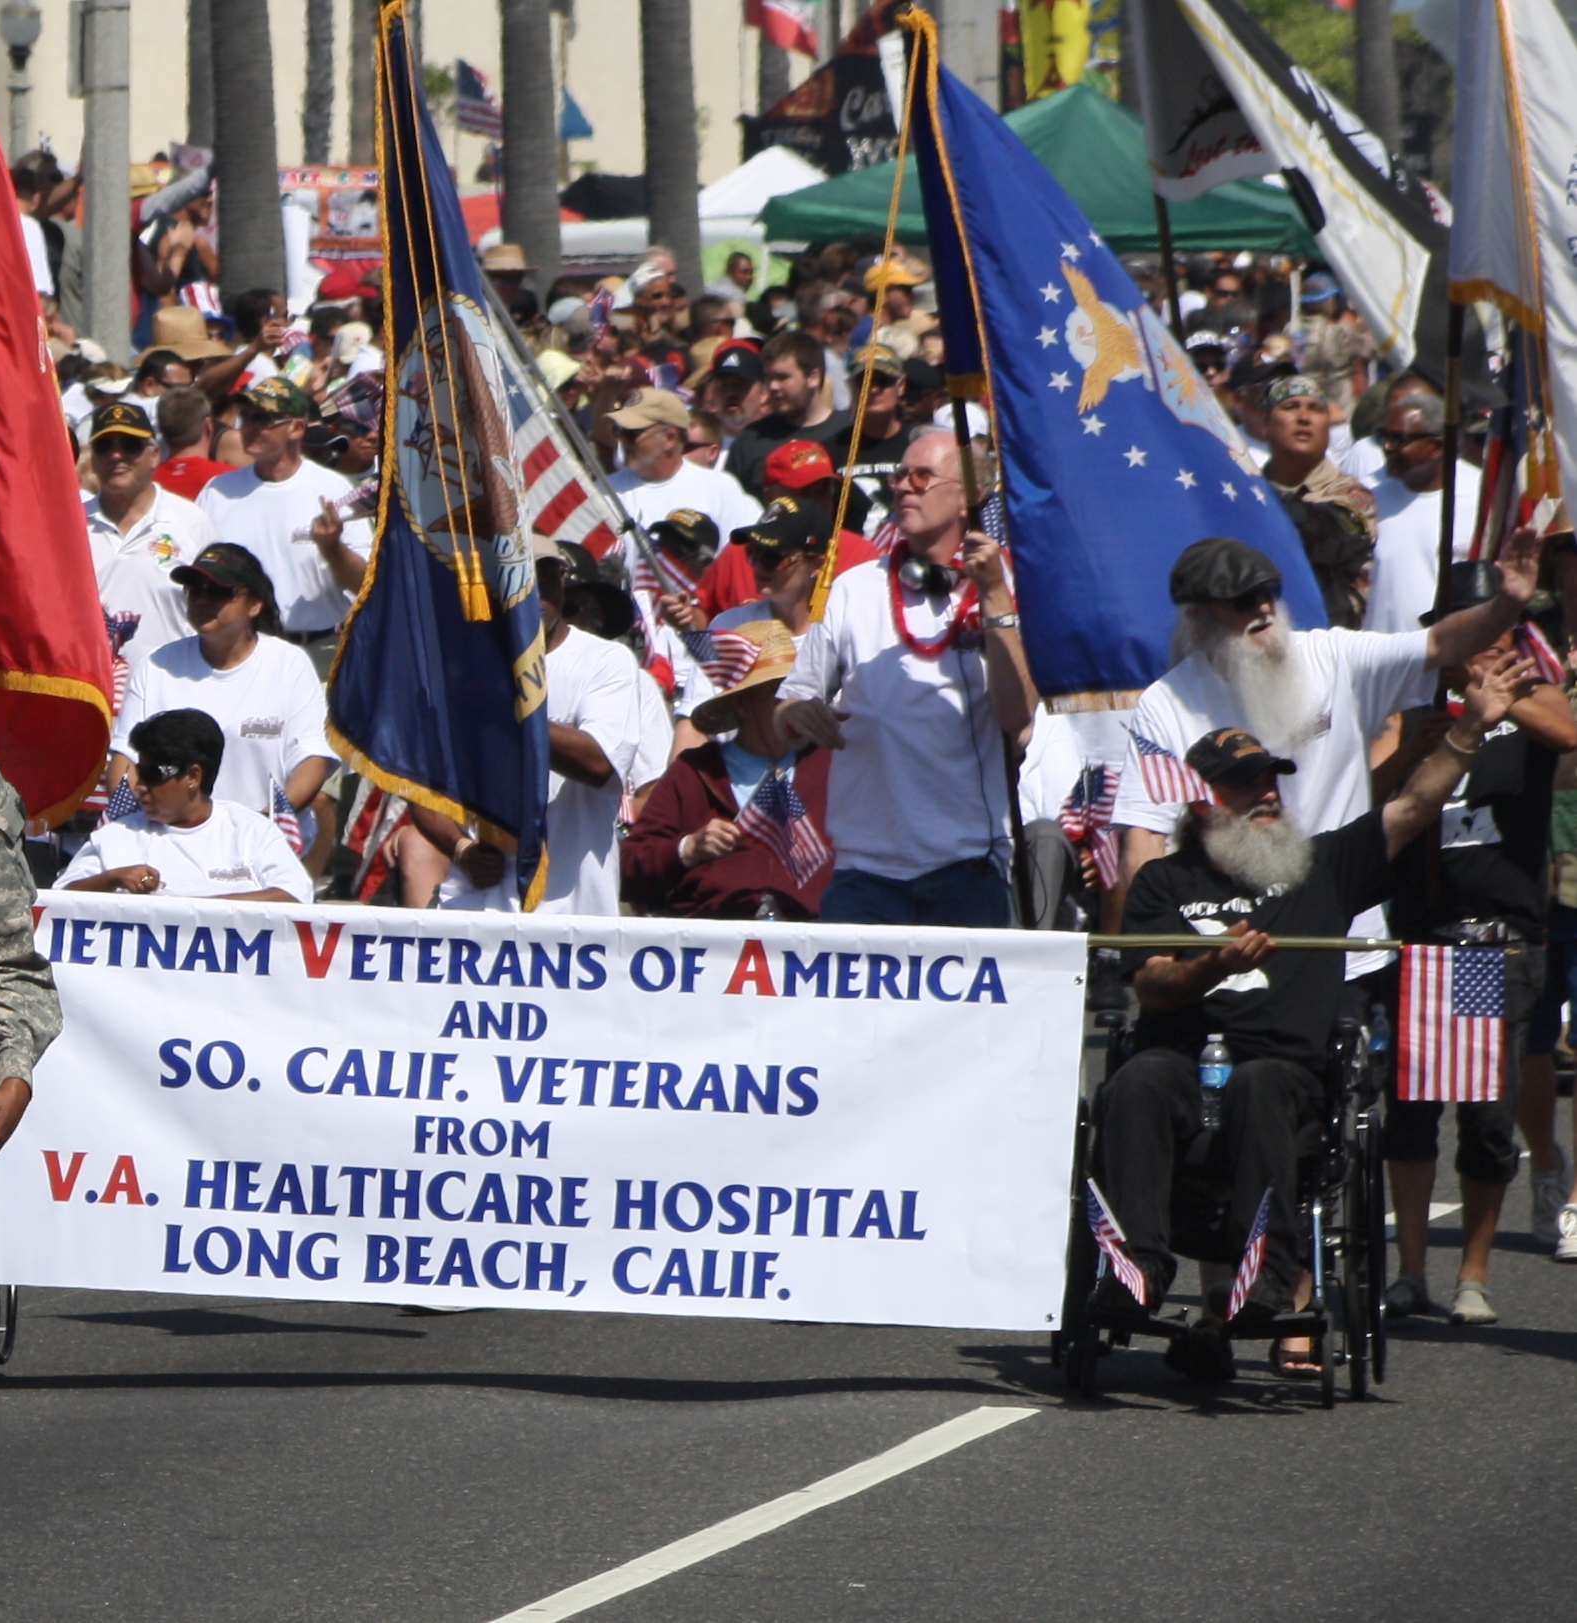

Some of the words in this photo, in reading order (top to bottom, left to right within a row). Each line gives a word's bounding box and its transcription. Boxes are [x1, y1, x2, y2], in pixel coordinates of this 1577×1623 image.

[297, 922, 607, 990] VETERANS
[631, 945, 707, 992] OF
[726, 940, 1007, 1003] AMERICA
[442, 1000, 548, 1041] AND
[160, 1038, 261, 1091] SO.
[287, 1046, 469, 1102] CALIF.
[497, 1055, 819, 1116] VETERANS
[416, 1115, 551, 1158] FROM
[45, 1151, 159, 1205] V.A.
[184, 1158, 590, 1228] HEALTHCARE
[615, 1179, 927, 1240] HOSPITAL
[165, 1224, 340, 1280] LONG
[365, 1234, 587, 1296] BEACH,
[613, 1246, 791, 1300] CALIF.
